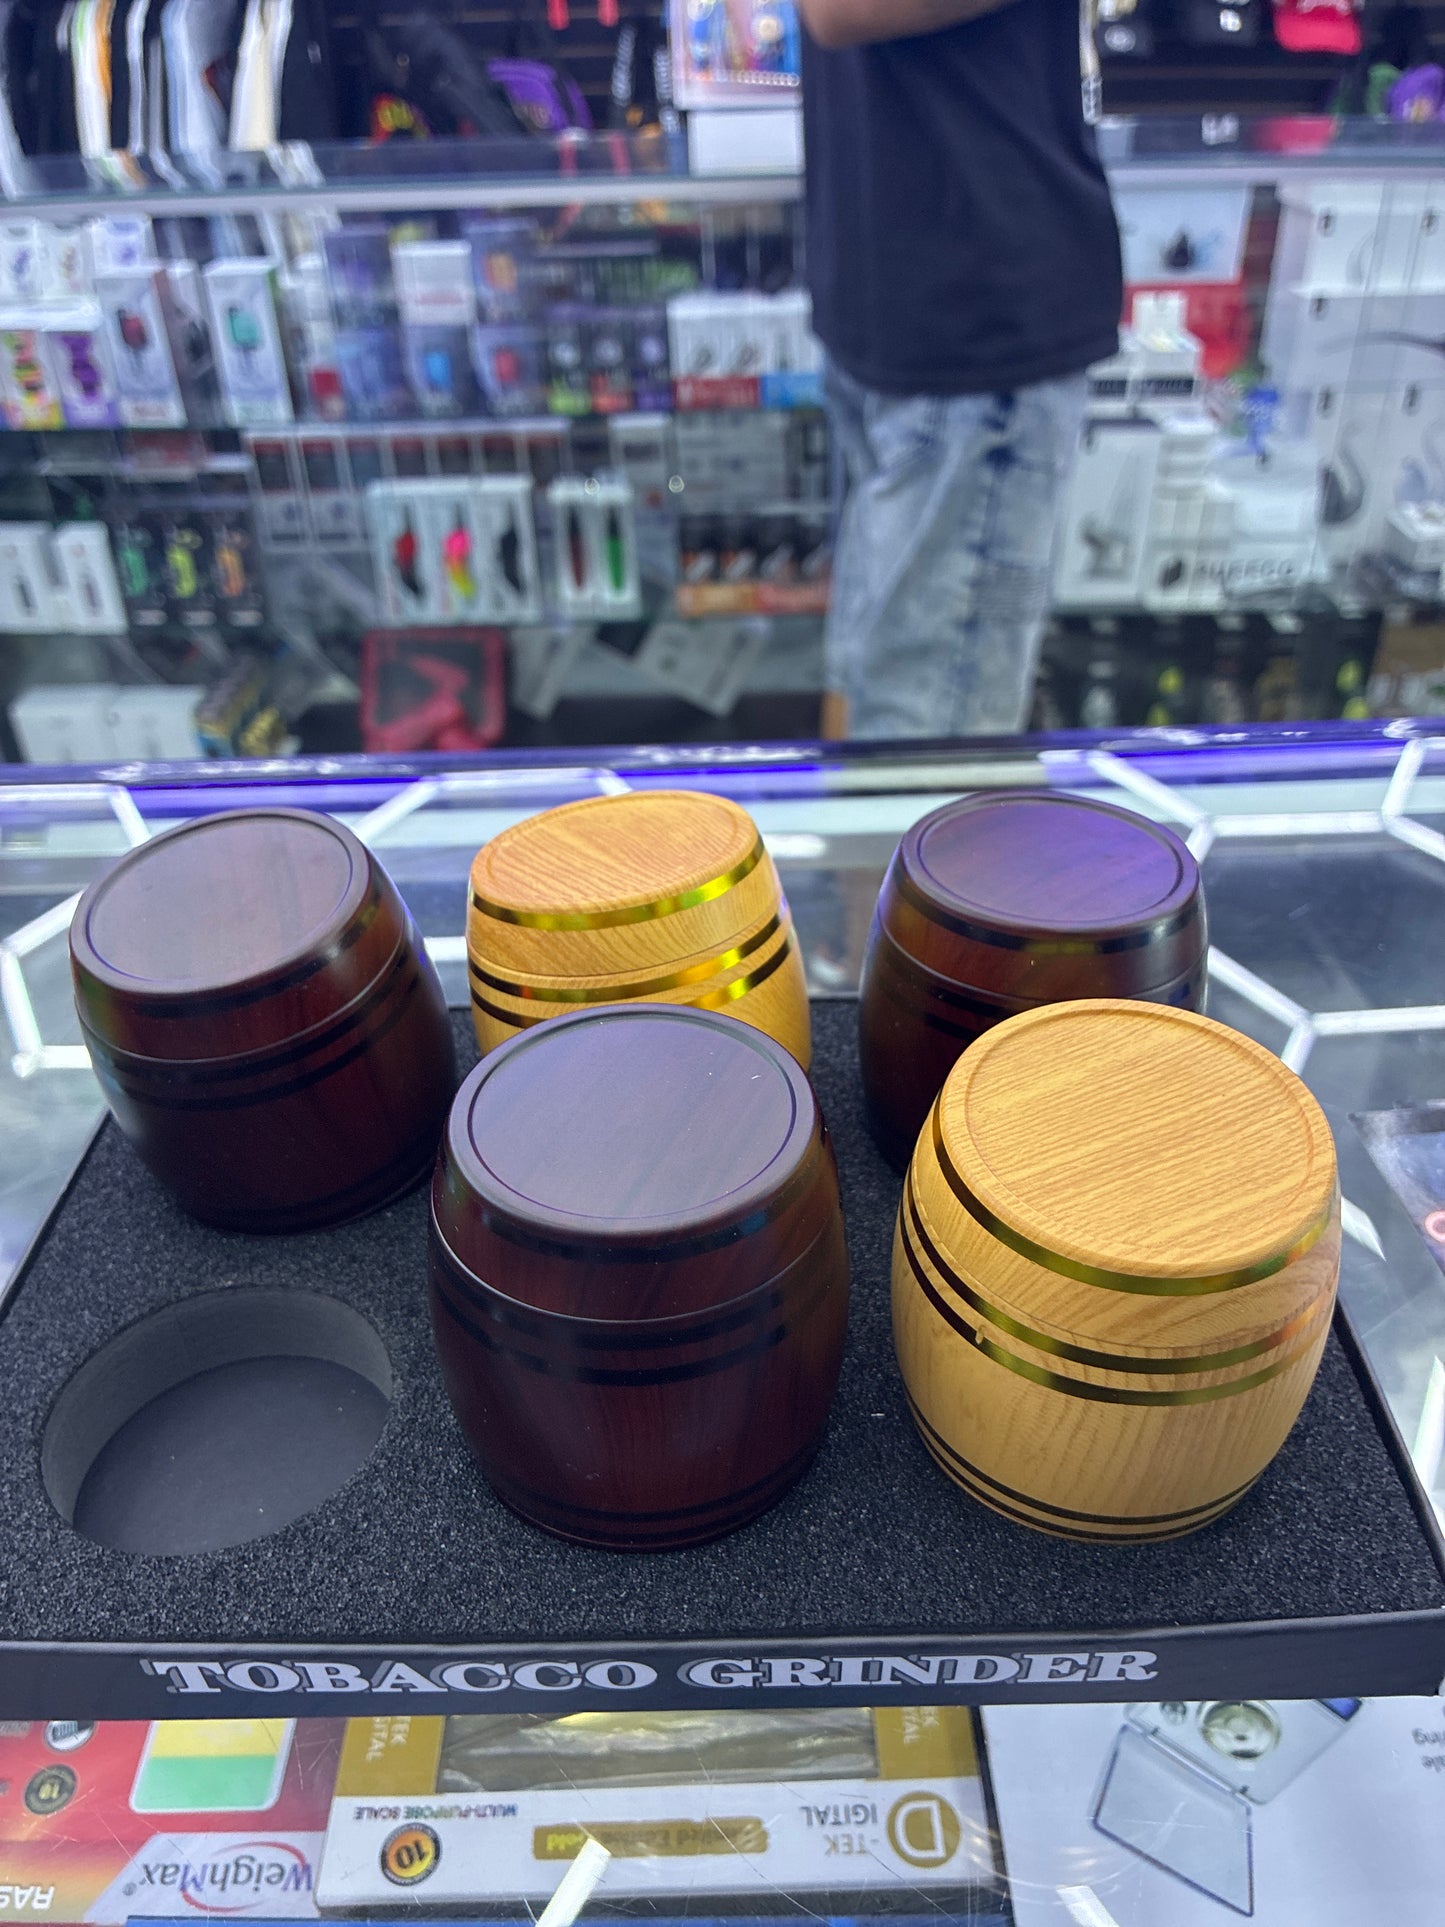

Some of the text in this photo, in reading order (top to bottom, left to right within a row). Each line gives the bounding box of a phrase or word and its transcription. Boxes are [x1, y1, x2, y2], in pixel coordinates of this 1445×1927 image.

[140, 1650, 1160, 1694] TOBACCO GRINDER
[352, 1804, 519, 1820] MULTI-PURPOSE SCALE
[394, 1838, 430, 1871] 10
[139, 1854, 314, 1897] WeighMax
